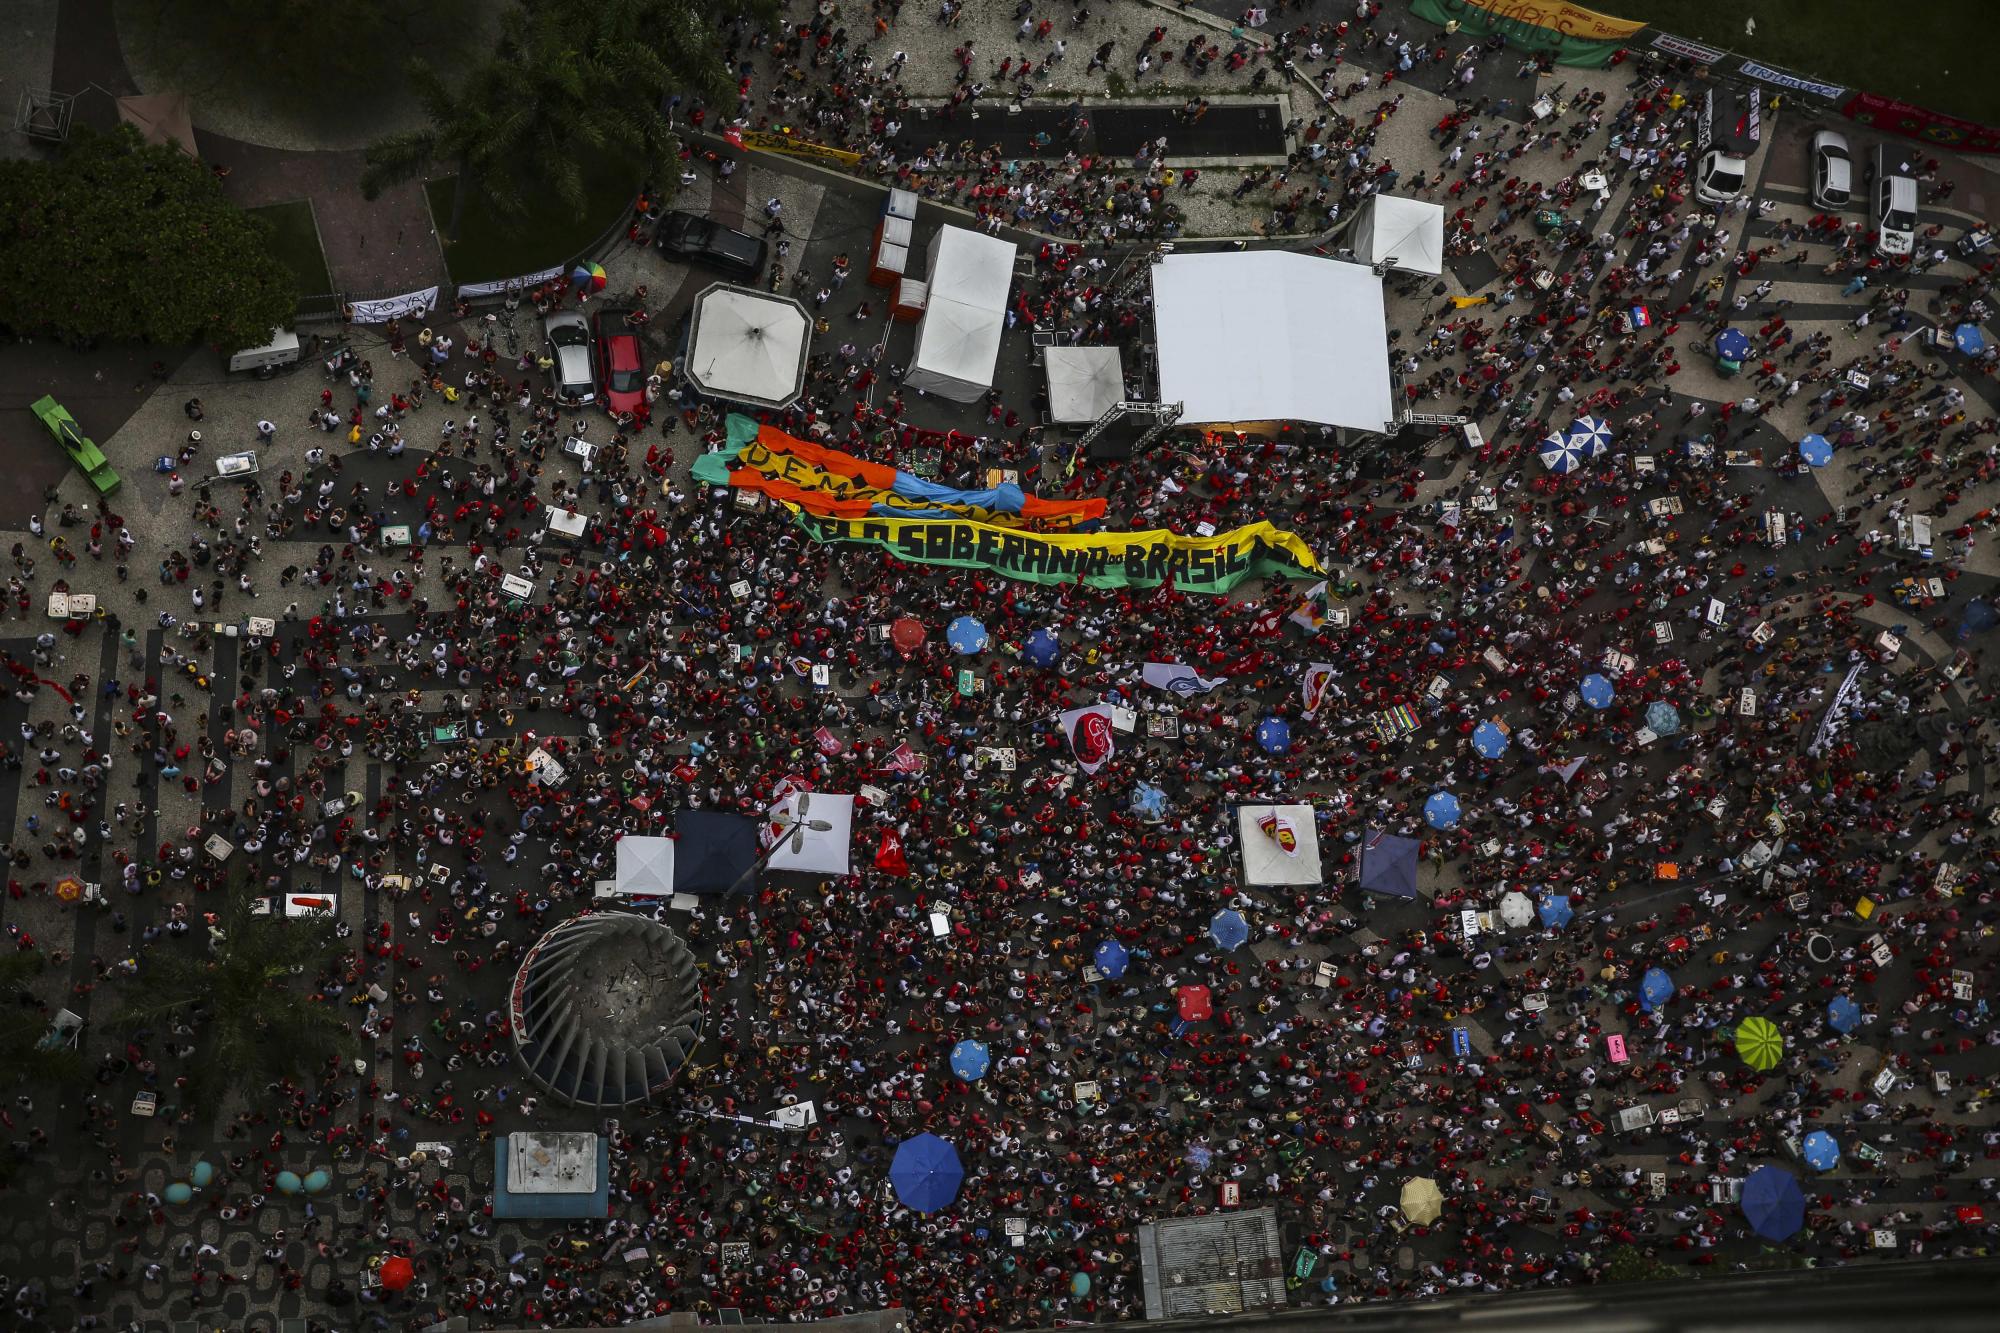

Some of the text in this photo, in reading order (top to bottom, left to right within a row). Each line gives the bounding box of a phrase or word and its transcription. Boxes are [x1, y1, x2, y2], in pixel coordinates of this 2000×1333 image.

[357, 302, 394, 315] NÃO
[399, 292, 427, 308] VAI
[898, 524, 1109, 577] SOBERANIA
[1124, 543, 1248, 584] BRASIL
